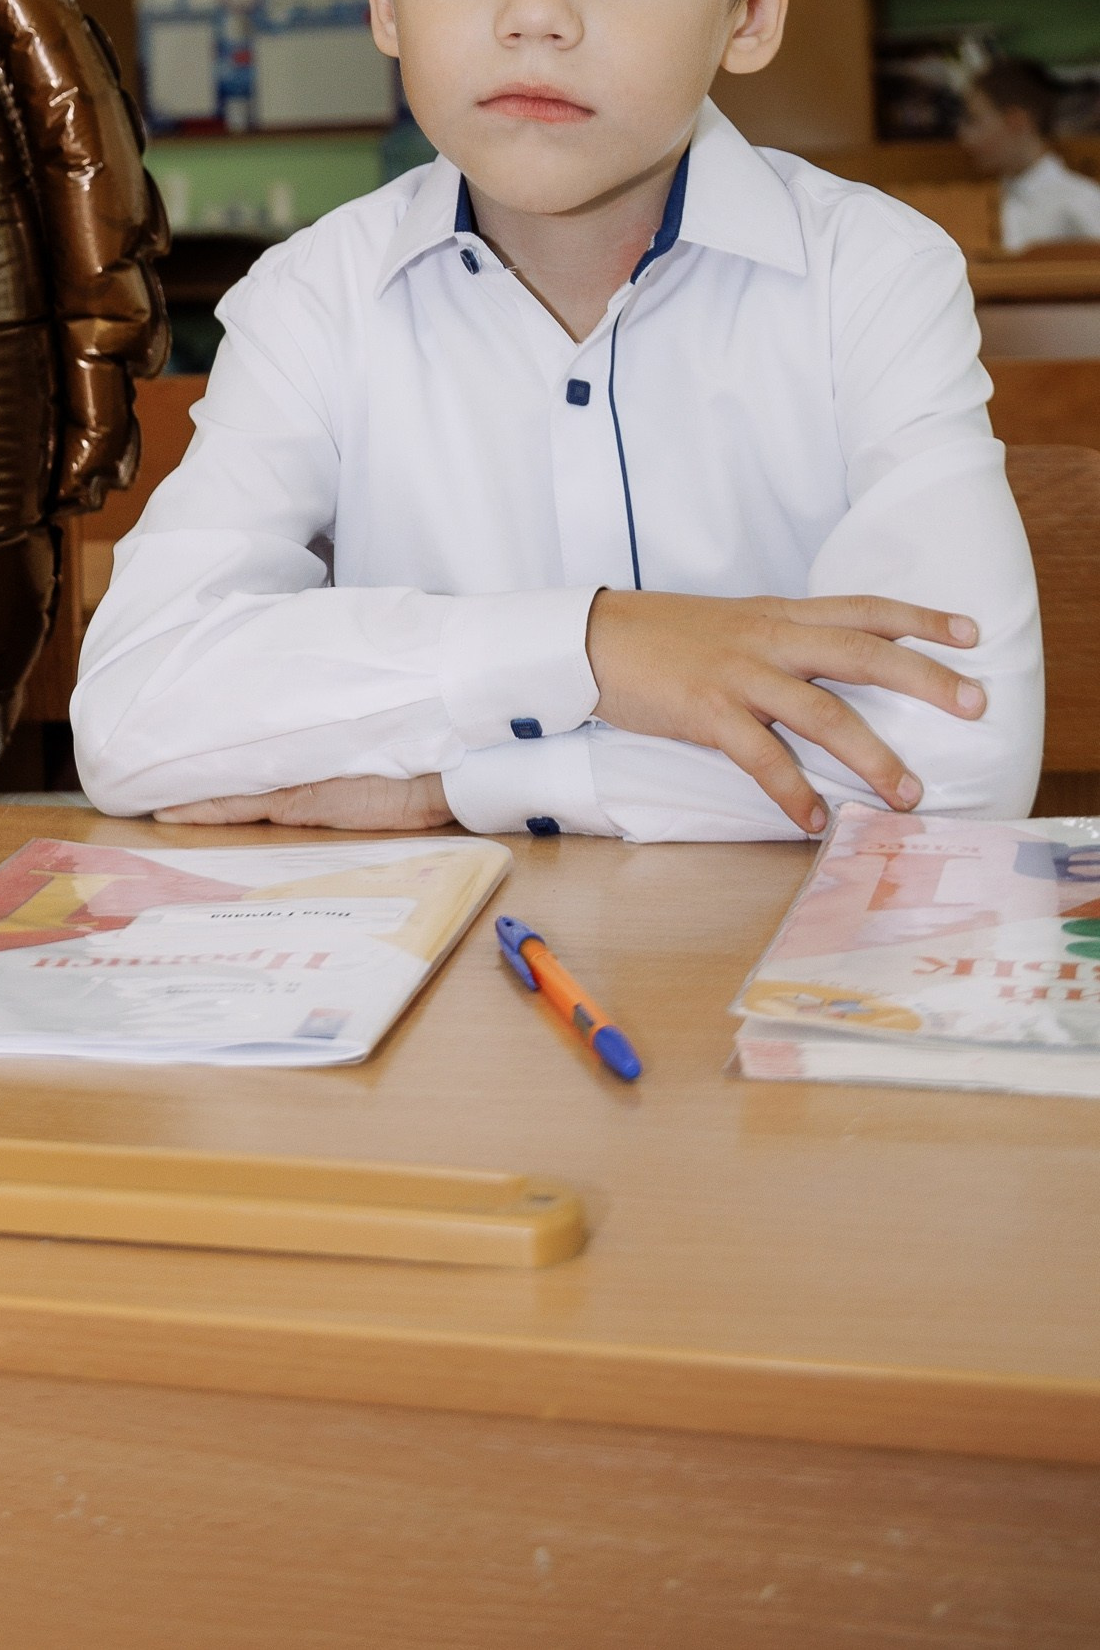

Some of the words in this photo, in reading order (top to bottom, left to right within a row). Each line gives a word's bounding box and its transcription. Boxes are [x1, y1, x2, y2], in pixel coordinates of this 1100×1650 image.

[855, 850, 982, 911] 1
[30, 949, 331, 970] Прописи
[912, 955, 1100, 981] ык
